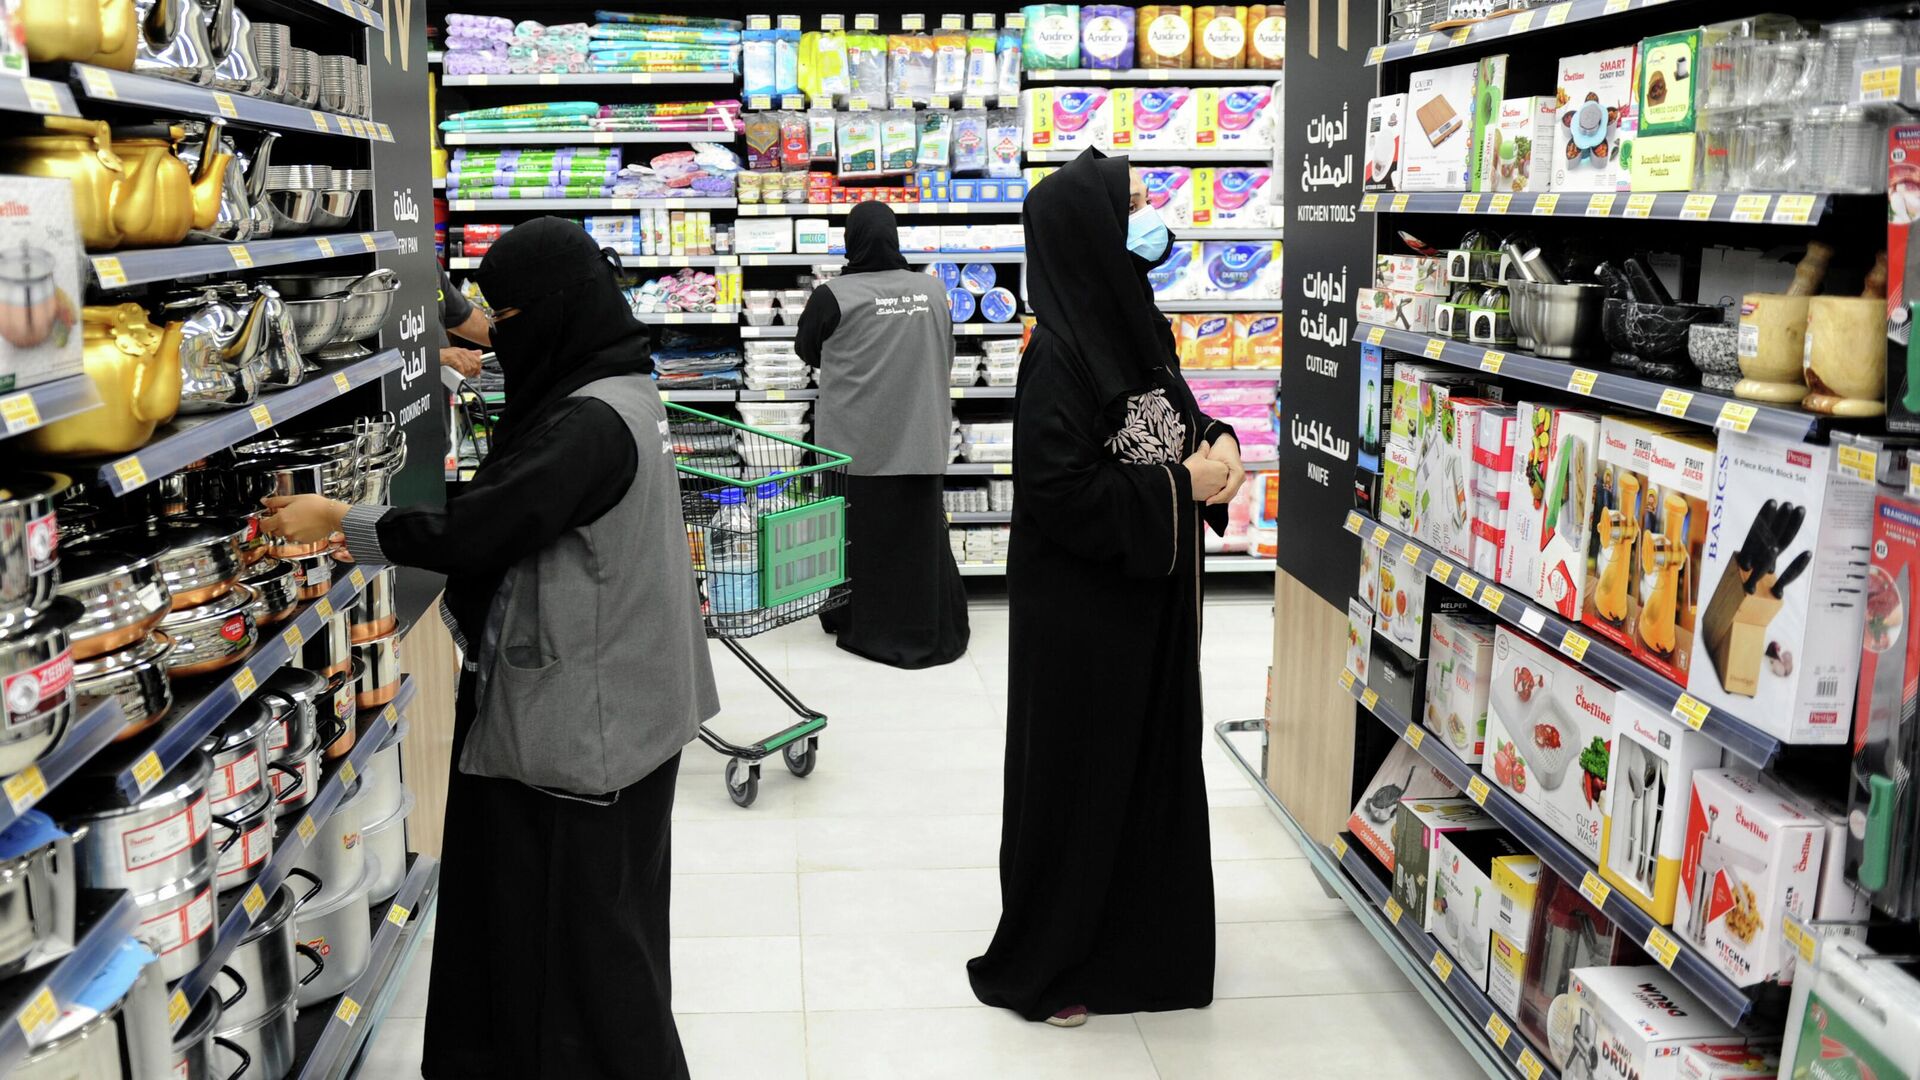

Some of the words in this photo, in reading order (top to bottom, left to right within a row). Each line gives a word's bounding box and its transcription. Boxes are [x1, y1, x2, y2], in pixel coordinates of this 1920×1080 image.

[1038, 31, 1073, 42] Andrex
[1088, 32, 1123, 43] Andrex
[1152, 31, 1187, 41] Andrex
[1209, 32, 1242, 42] Andrex
[1257, 32, 1285, 42] Andre
[1600, 59, 1626, 72] SMART
[1600, 72, 1614, 80] CANDY
[1615, 70, 1625, 78] BOX
[1063, 95, 1082, 107] fine
[1144, 94, 1163, 107] fine
[1229, 94, 1246, 107] fine
[1307, 102, 1348, 148] أدوات
[1224, 173, 1241, 186] fine
[1302, 154, 1352, 192] المطبخ
[0, 201, 29, 217] efline
[393, 188, 419, 223] مقلاة
[1298, 205, 1328, 222] KITCHEN
[1330, 205, 1356, 222] TOOLS
[398, 238, 408, 255] FRY
[409, 236, 418, 254] PAN
[1226, 247, 1248, 261] fine
[1222, 271, 1248, 279] DUETTO
[875, 297, 898, 306] happy
[913, 294, 928, 302] help
[1300, 308, 1348, 347] المائدة
[1204, 347, 1229, 355] SUPER
[1255, 346, 1280, 354] SUPER
[1306, 354, 1339, 378] CUTLERY
[1401, 370, 1416, 383] Tefal
[400, 400, 420, 426] COOKING
[420, 393, 431, 417] POT
[1291, 413, 1350, 461] سكاكين
[1606, 434, 1627, 451] Chefline
[1392, 450, 1407, 465] Tefal
[1633, 447, 1651, 461] JUICE
[1651, 453, 1676, 470] Chefline
[1685, 457, 1704, 470] FRUIT
[1740, 459, 1756, 470] Piece
[1757, 463, 1774, 475] Knife
[1776, 467, 1793, 479] Block
[1795, 473, 1806, 484] Set
[1307, 461, 1330, 487] KNIFE
[1682, 468, 1703, 481] JUICER
[1708, 455, 1729, 560] BASICS
[1575, 693, 1612, 724] Chefline
[1810, 713, 1837, 723] Prestige
[1634, 721, 1657, 743] Chefline
[1576, 813, 1589, 827] CUT
[1590, 821, 1598, 837] &
[1736, 812, 1769, 842] Chefline
[1577, 825, 1598, 849] WASH
[1799, 832, 1812, 872] Chefline
[1716, 938, 1750, 973] KITCHEN
[1612, 1037, 1633, 1063] SMART
[1655, 1046, 1681, 1057] ED21
[1602, 1040, 1640, 1080] DRUM
